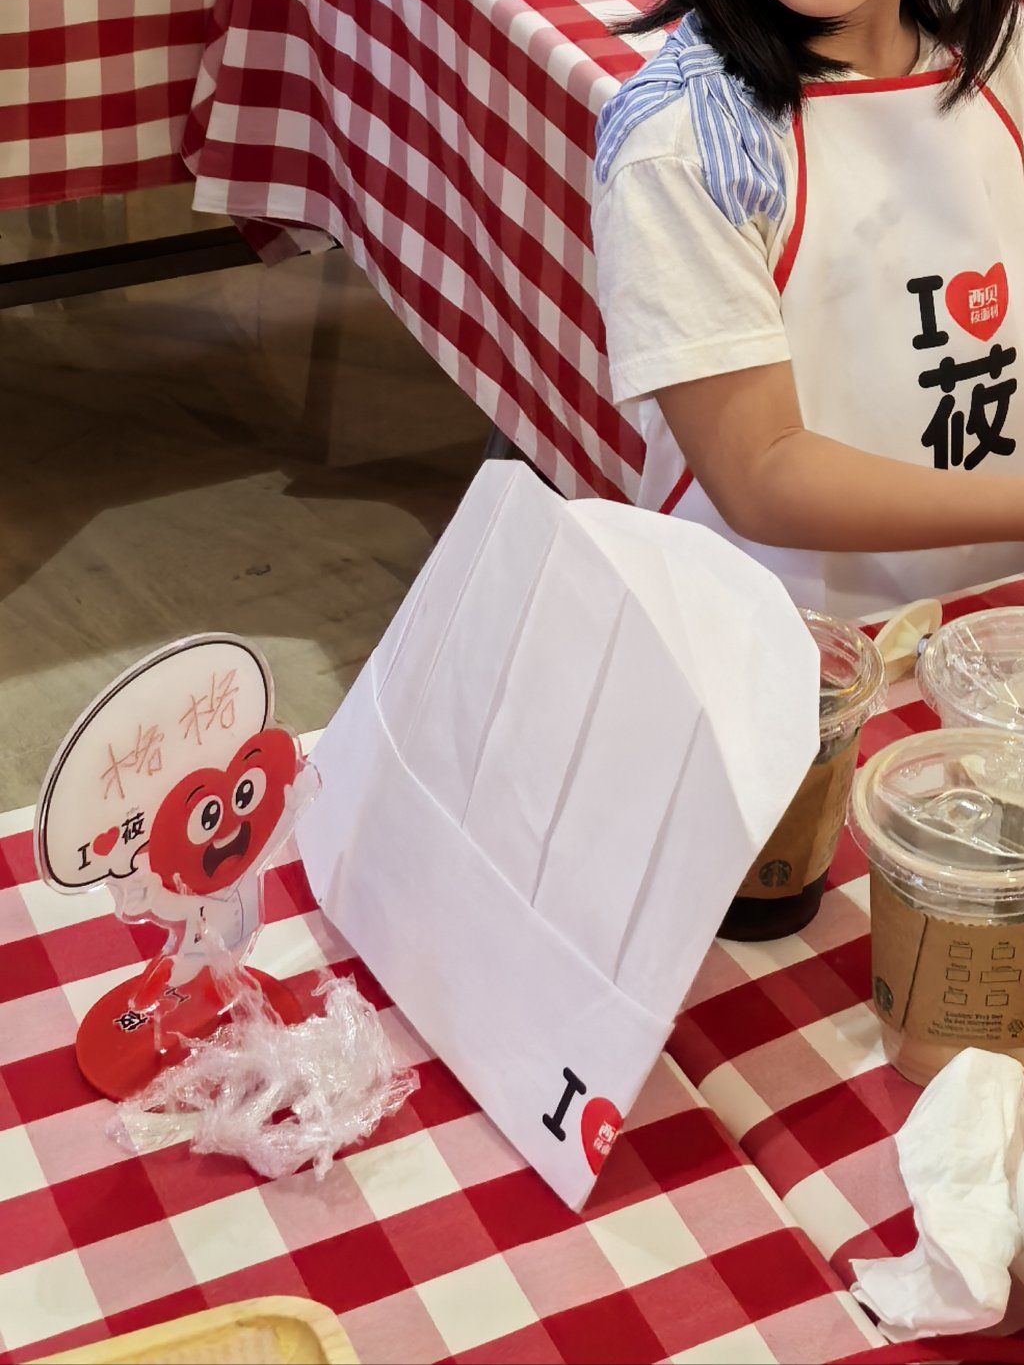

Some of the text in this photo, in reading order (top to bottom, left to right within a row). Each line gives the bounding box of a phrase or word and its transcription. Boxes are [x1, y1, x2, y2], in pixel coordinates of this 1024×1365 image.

[906, 275, 949, 350] I
[968, 284, 998, 309] 西贝
[918, 343, 1018, 471] 莜
[77, 842, 92, 871] I
[542, 1067, 587, 1142] I
